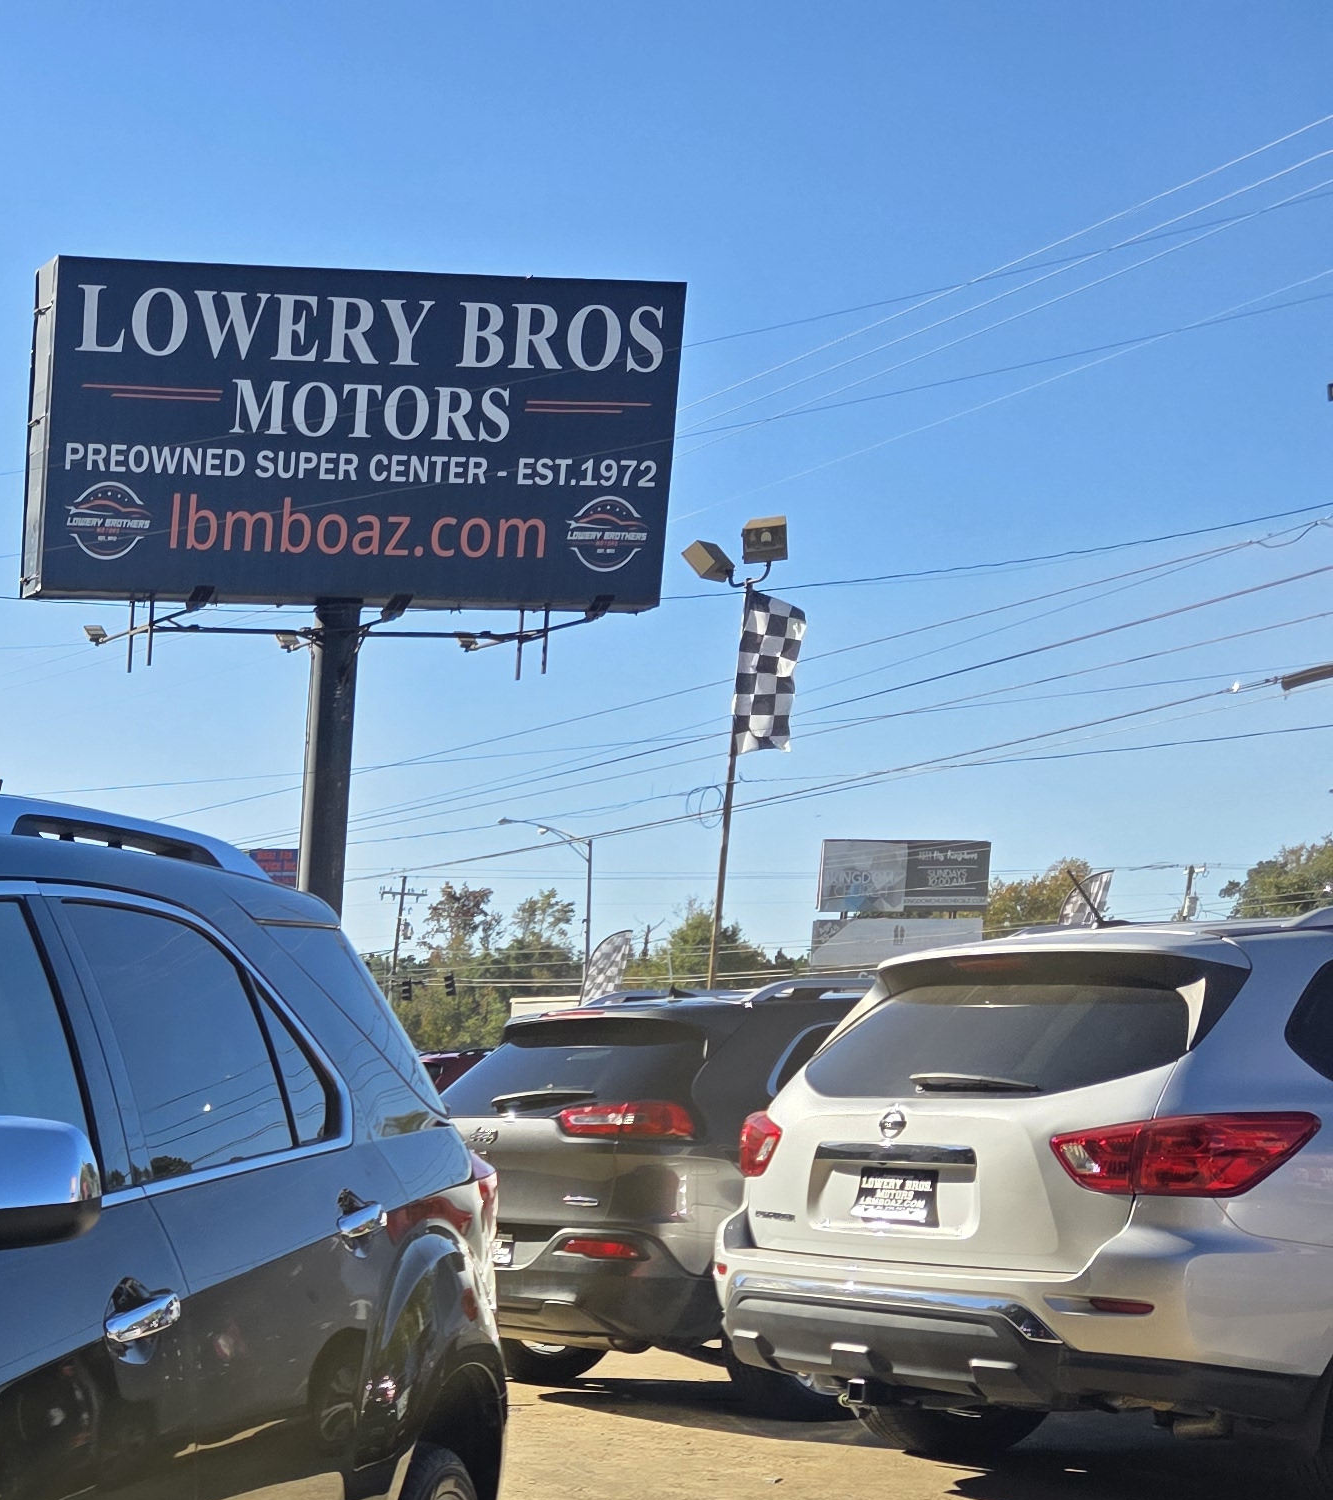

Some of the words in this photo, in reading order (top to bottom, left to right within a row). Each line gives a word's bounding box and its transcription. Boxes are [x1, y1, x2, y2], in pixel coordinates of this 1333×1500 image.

[74, 284, 436, 366] LOWERY
[455, 301, 664, 373] BROS
[228, 378, 510, 443] MOTORS
[64, 442, 246, 477] PREOWNED
[254, 450, 359, 481] SUPER
[369, 453, 488, 484] CENTER
[516, 457, 657, 488] EST.1972
[169, 492, 546, 559] lbmboaz.com
[927, 868, 968, 878] SUNDAYS
[860, 1177, 904, 1190] LOWERY
[875, 1188, 915, 1201] MOTORS
